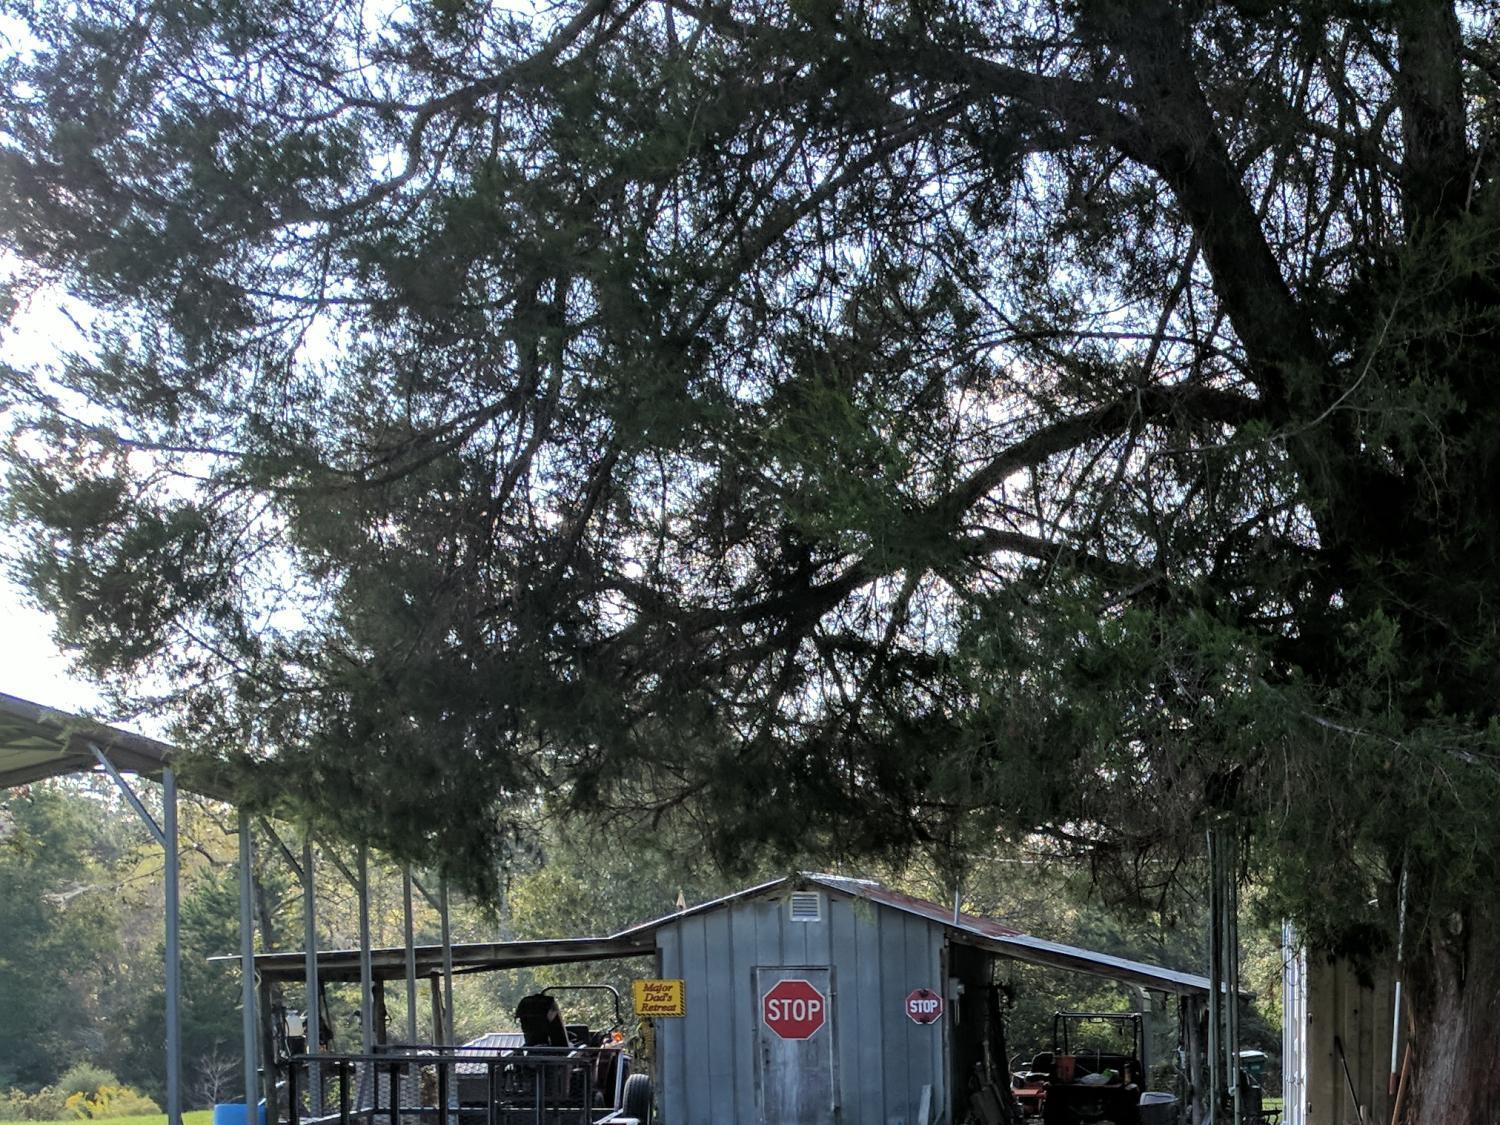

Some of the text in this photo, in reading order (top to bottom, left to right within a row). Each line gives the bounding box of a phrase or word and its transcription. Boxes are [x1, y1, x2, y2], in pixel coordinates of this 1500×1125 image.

[643, 983, 673, 994] Major
[644, 992, 673, 1002] Dad's
[641, 1003, 677, 1012] Retreat
[767, 999, 821, 1022] STOP
[909, 999, 938, 1014] STOP
